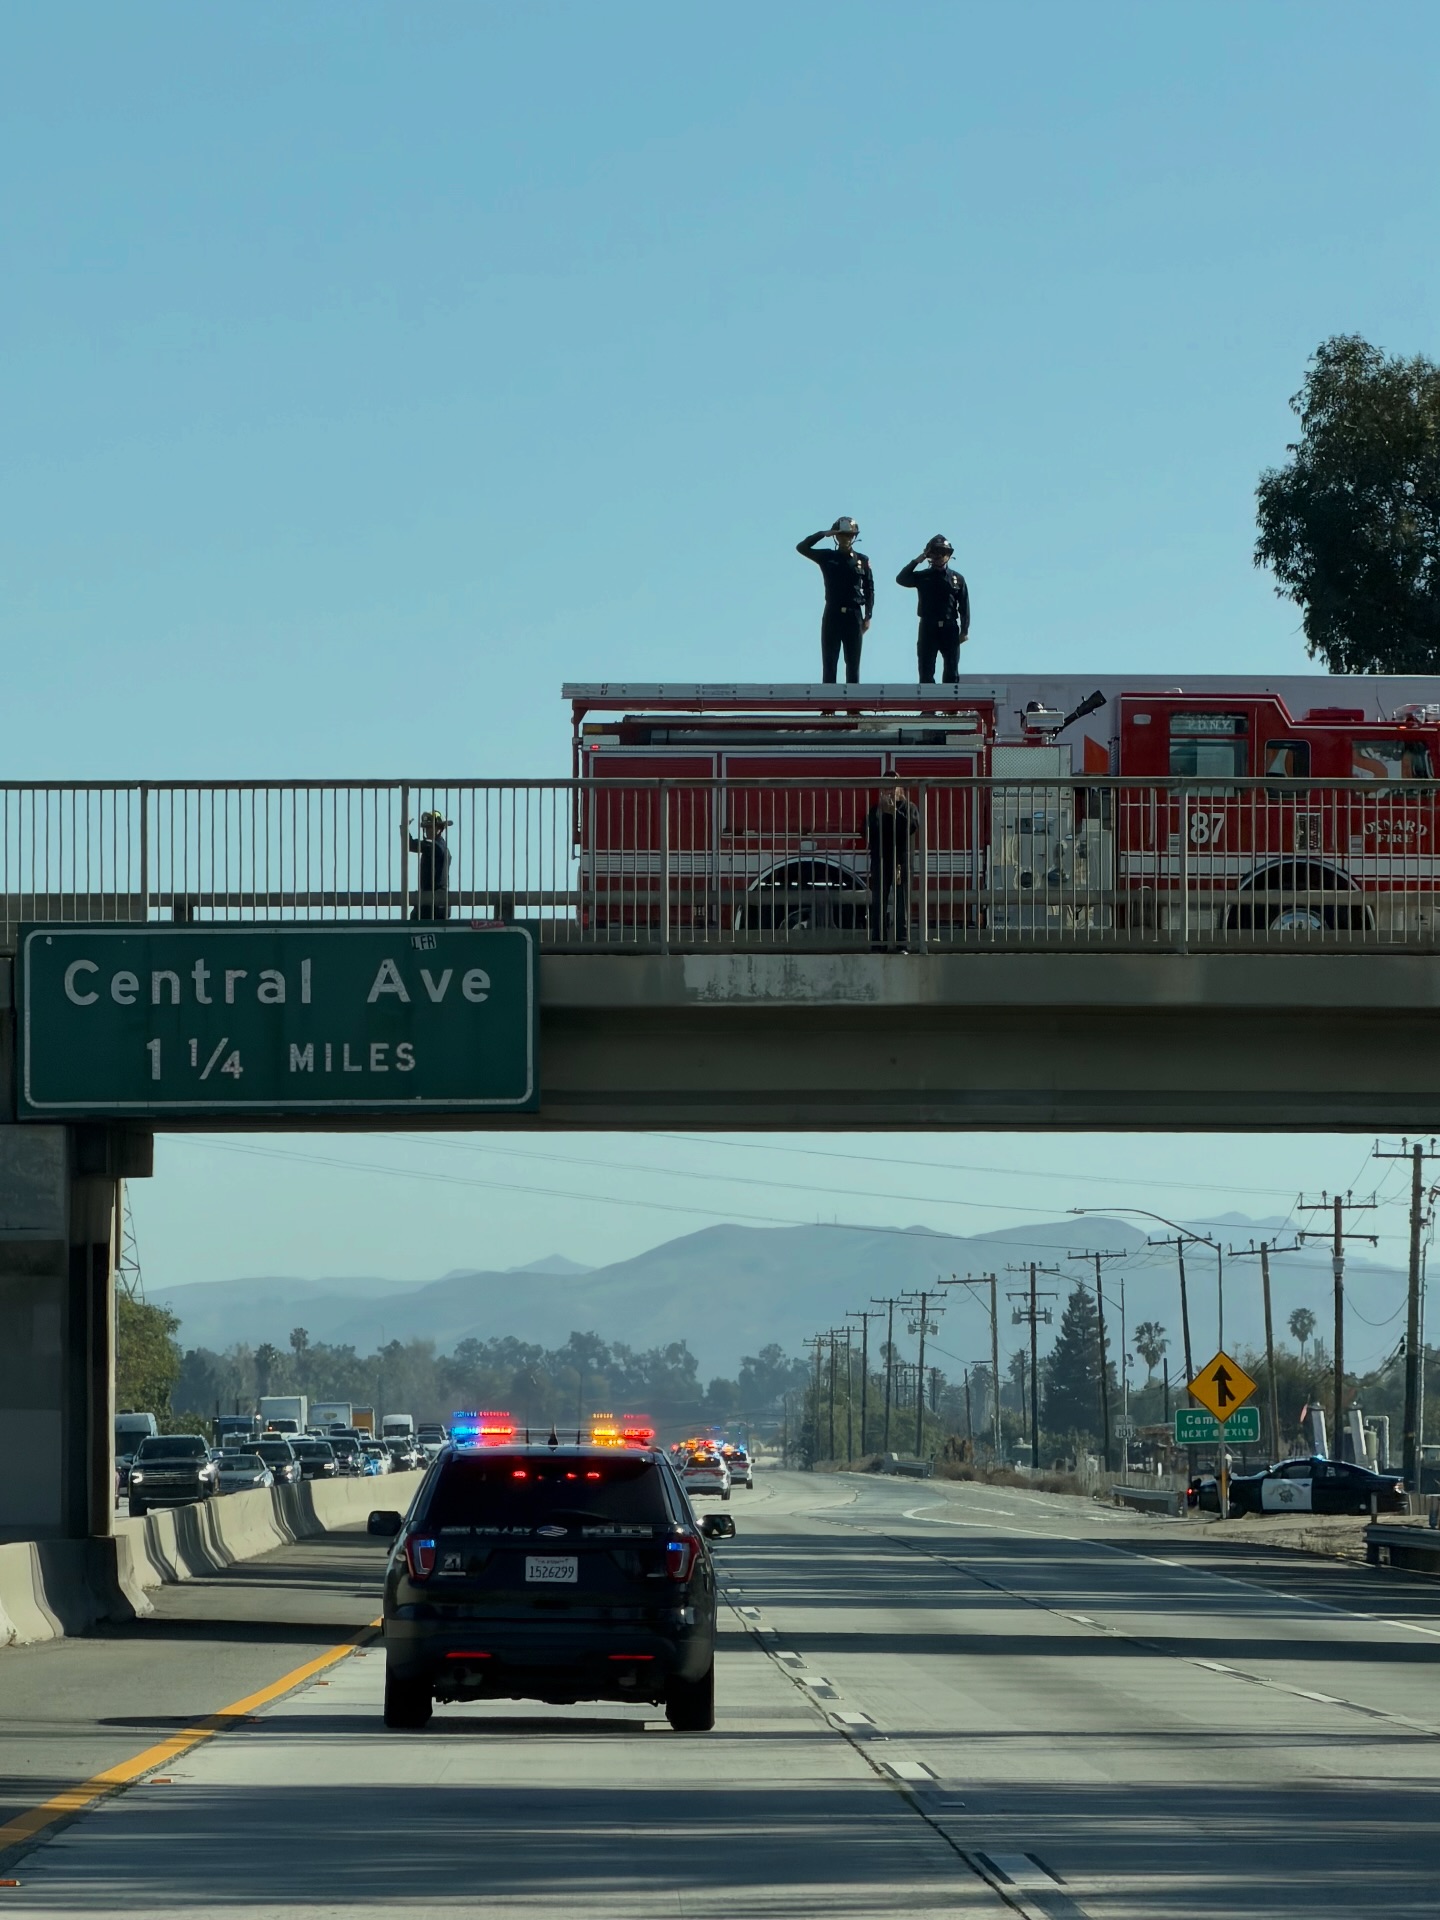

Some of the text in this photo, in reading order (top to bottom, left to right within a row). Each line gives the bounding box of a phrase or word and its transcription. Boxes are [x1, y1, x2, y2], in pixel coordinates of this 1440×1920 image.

[1190, 812, 1225, 844] 87
[1364, 819, 1428, 836] OXNARD
[1377, 833, 1414, 843] FIRE
[64, 958, 492, 1007] Central Ave
[145, 1038, 162, 1081] 1
[289, 1042, 416, 1072] MILES
[529, 1565, 575, 1579] 1526299
